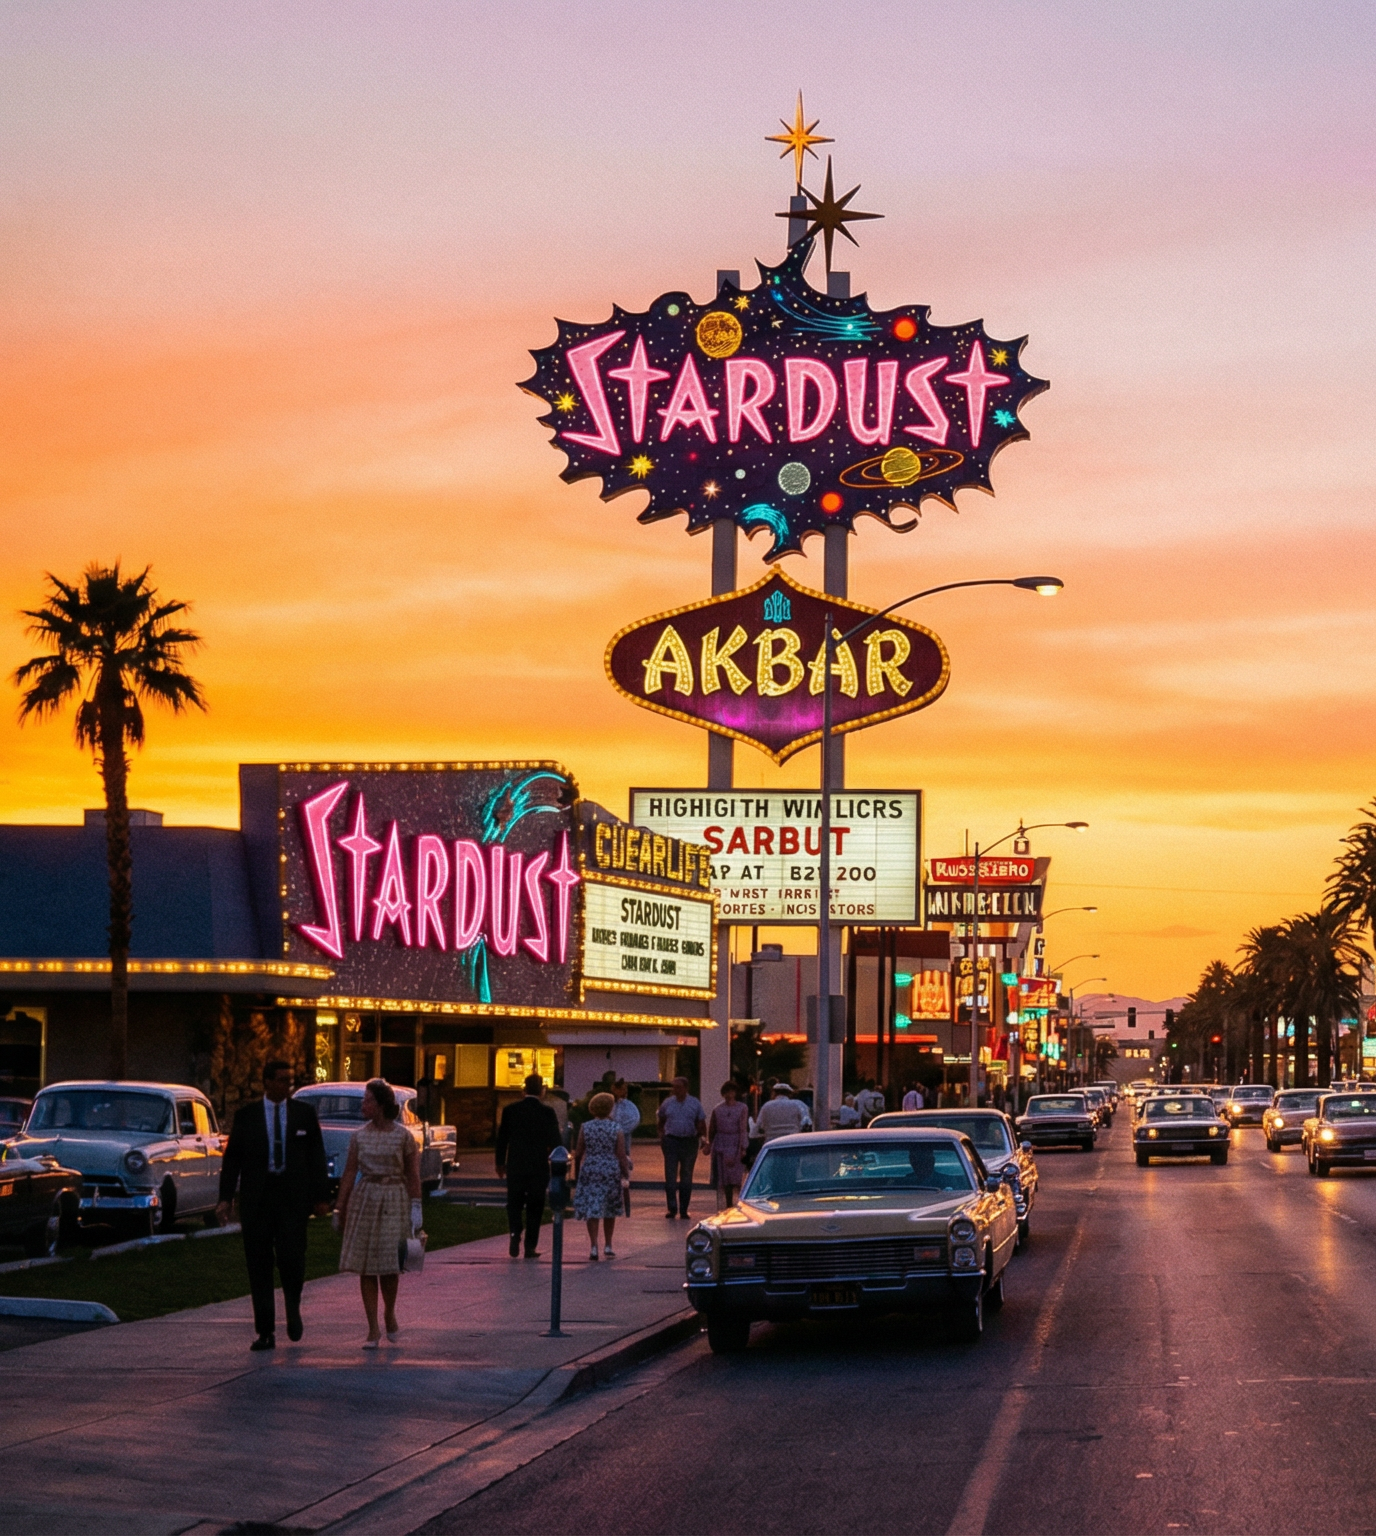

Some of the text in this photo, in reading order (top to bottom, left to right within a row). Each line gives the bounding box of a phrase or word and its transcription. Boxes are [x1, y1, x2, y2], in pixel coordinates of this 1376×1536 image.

[561, 329, 1011, 456] STARDUST
[642, 624, 914, 699] AKBAR
[703, 825, 851, 856] SARBUT
[299, 781, 581, 963] STARDUST
[741, 866, 764, 879] AT
[836, 867, 876, 881] 200
[621, 897, 682, 931] STARDUST
